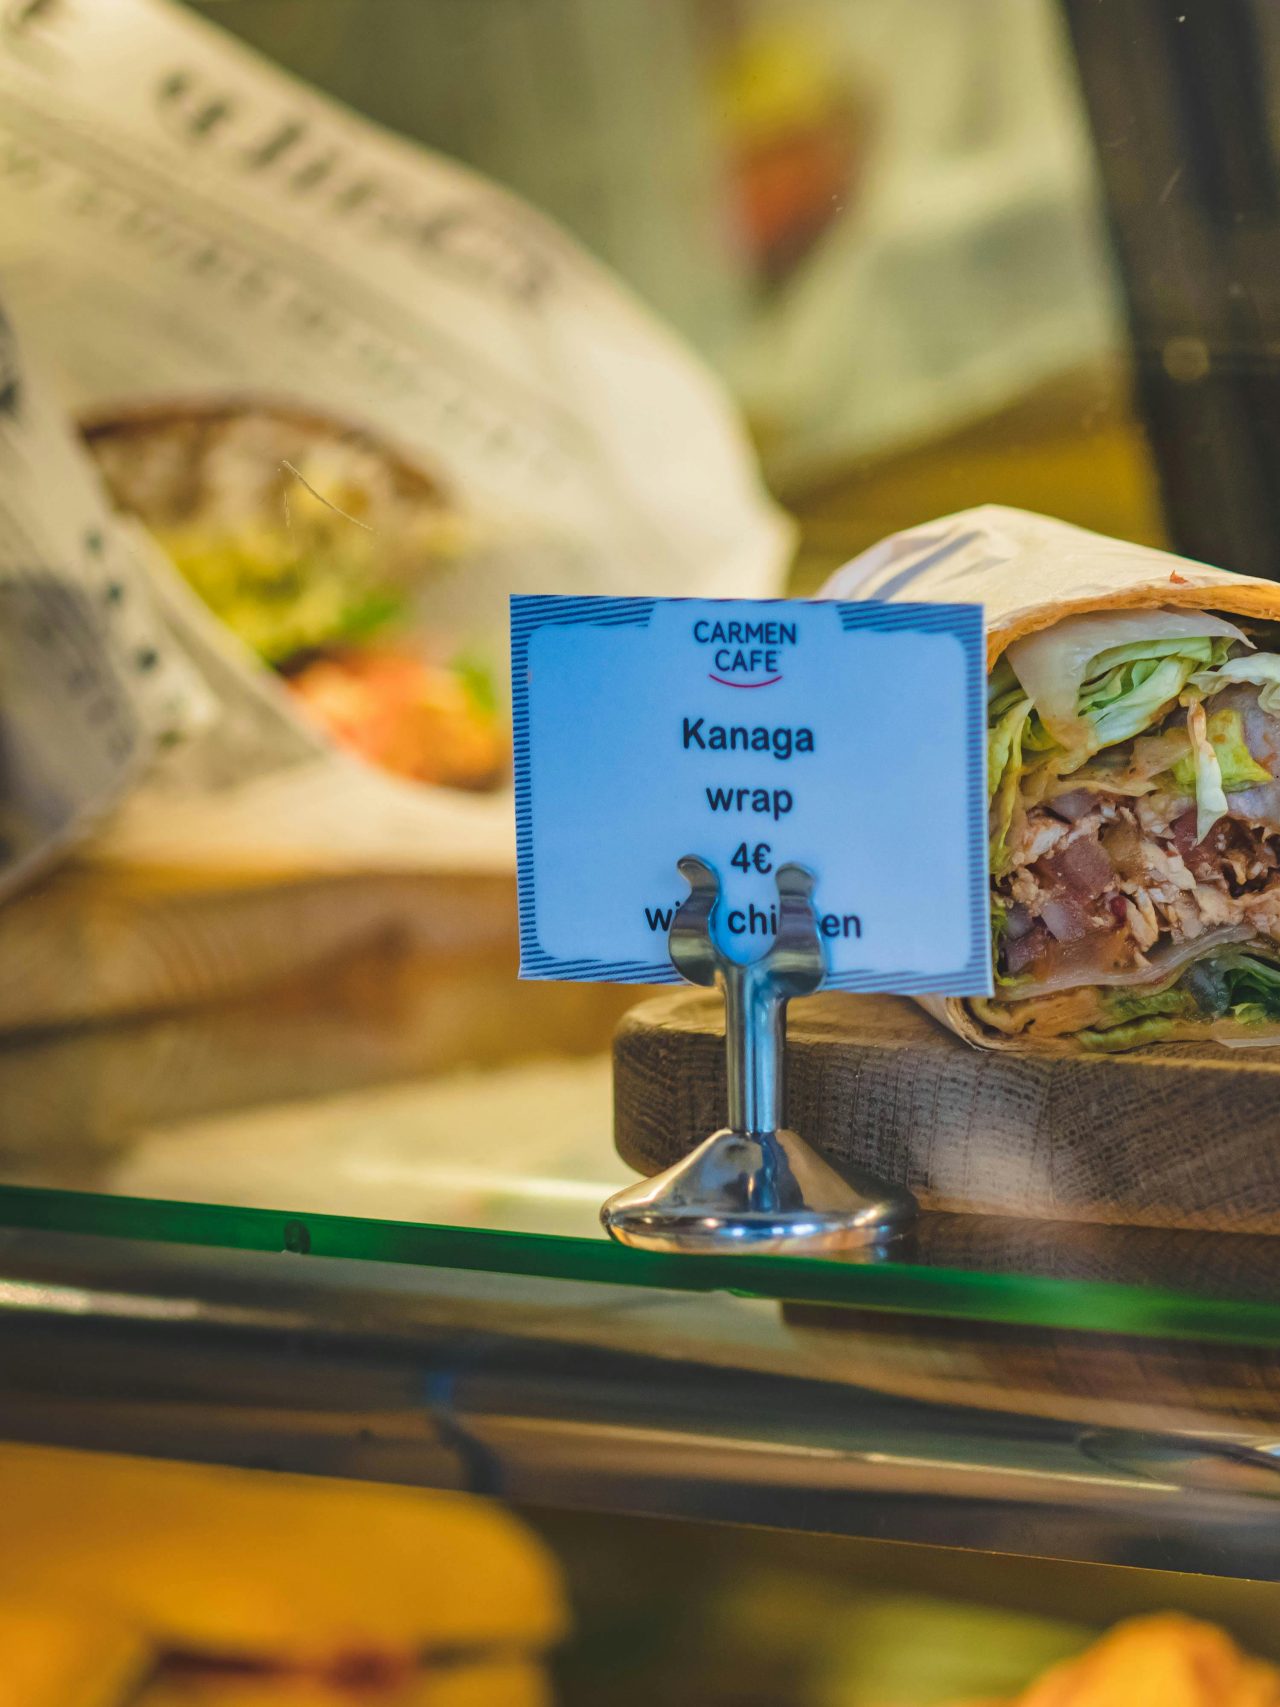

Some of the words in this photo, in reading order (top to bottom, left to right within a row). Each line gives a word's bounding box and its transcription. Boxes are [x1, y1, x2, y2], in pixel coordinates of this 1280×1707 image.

[694, 621, 797, 645] CARMEN
[715, 650, 779, 673] CAFE
[682, 718, 815, 760] Kanaga
[706, 787, 793, 820] wrap
[730, 842, 772, 874] 4€
[728, 904, 861, 938] chien
